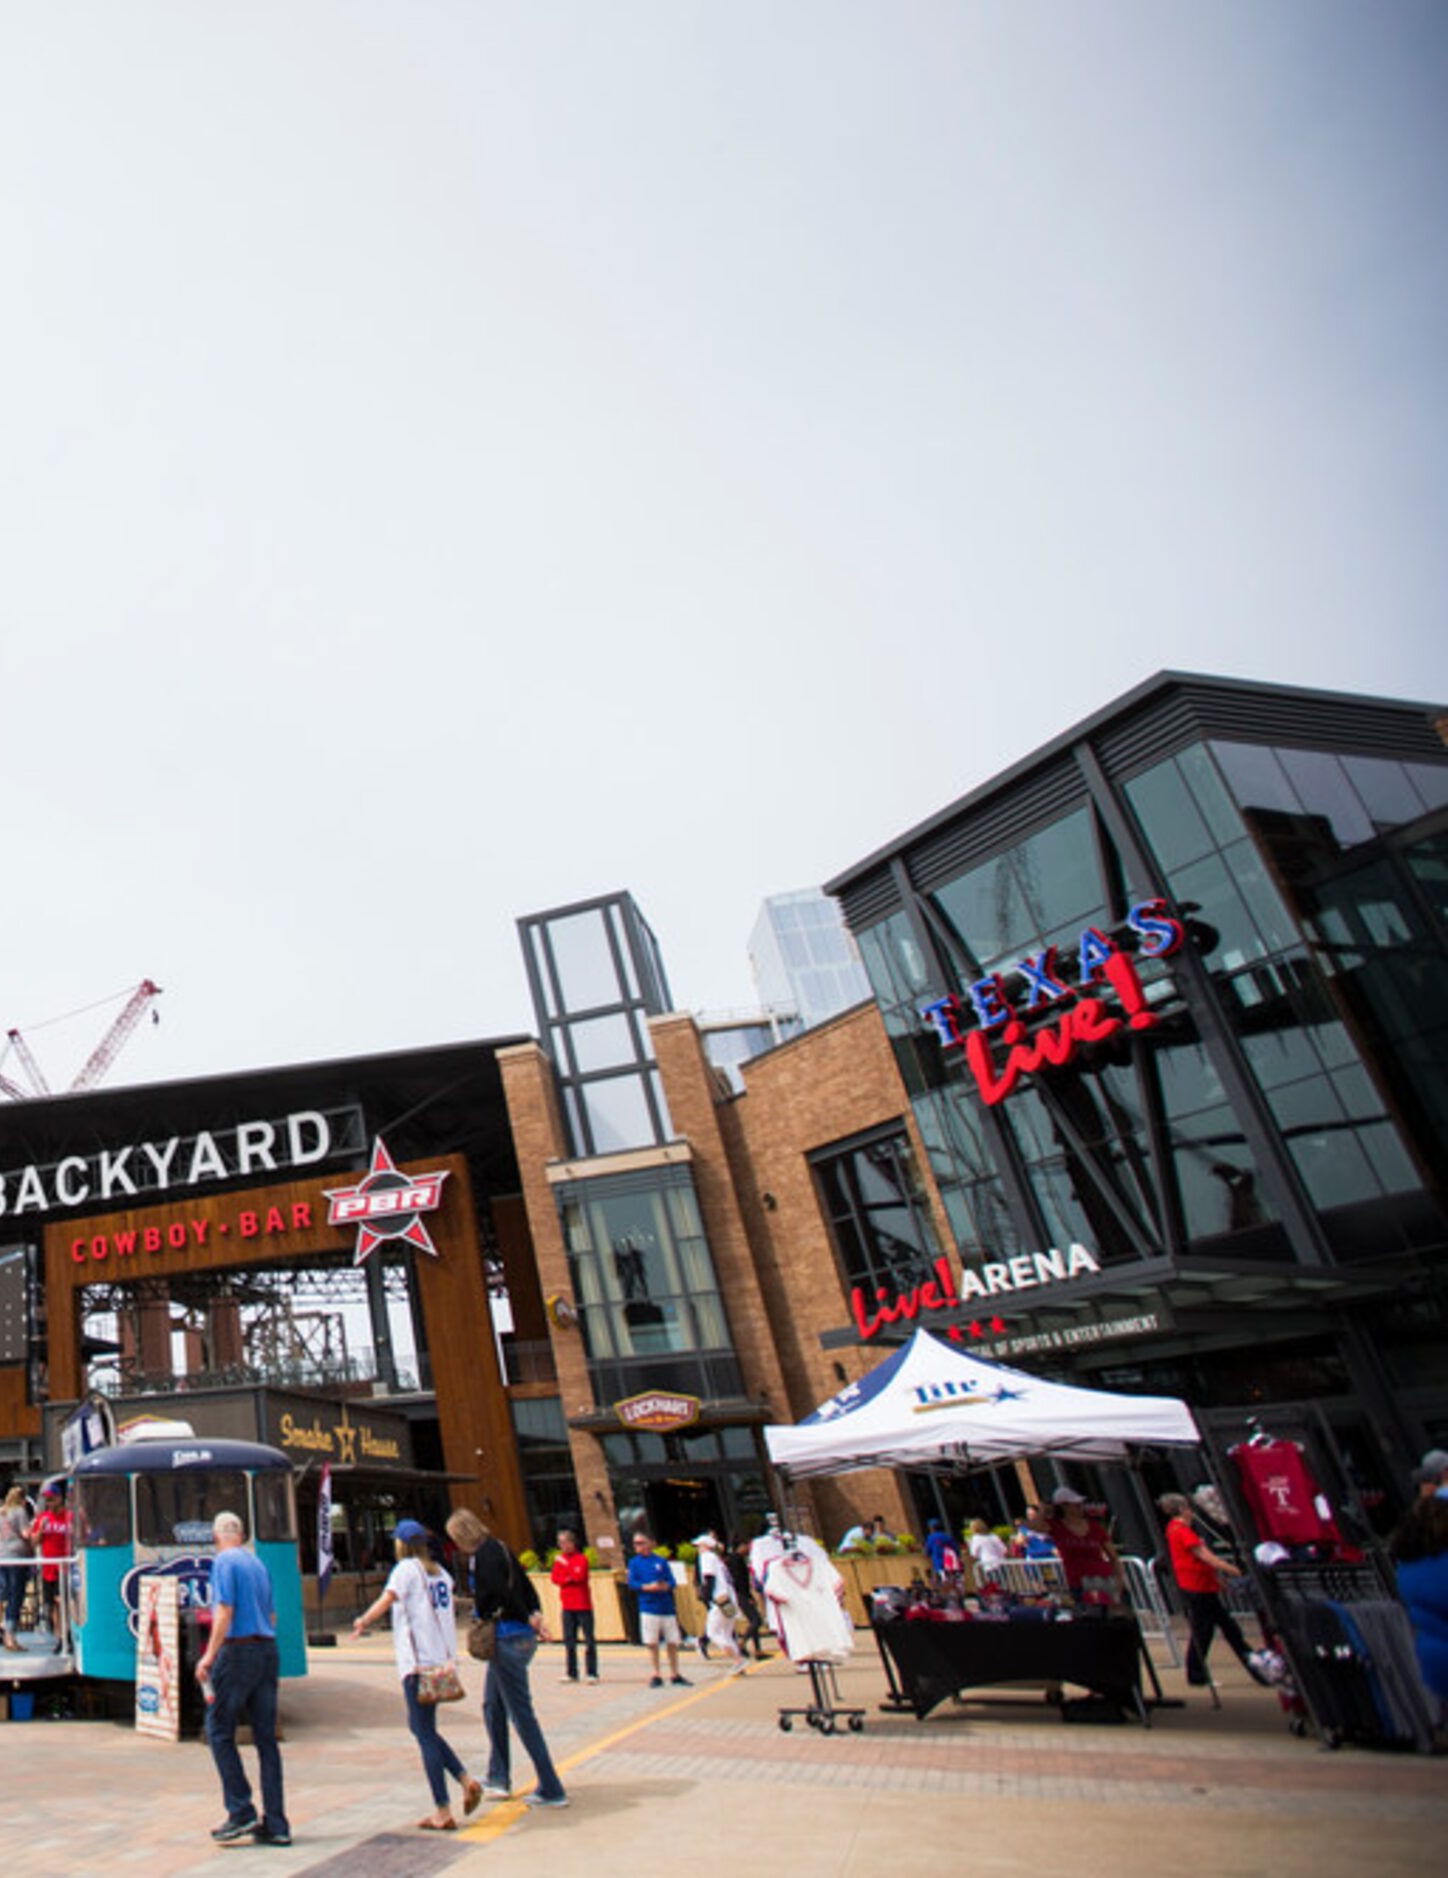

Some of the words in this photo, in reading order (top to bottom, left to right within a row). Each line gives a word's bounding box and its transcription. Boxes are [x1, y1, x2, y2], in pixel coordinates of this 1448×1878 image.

[918, 897, 1185, 1048] TEXAS
[966, 952, 1160, 1105] Live!
[336, 1185, 435, 1218] PBR
[71, 1219, 209, 1264] COWBOY
[239, 1202, 313, 1238] BAR
[851, 1256, 960, 1339] Live!
[960, 1243, 1101, 1300] ARENA
[1010, 1333, 1052, 1354] SPORTS
[1063, 1314, 1158, 1344] ENTERTAINMENT
[280, 1413, 335, 1452] Smoke
[359, 1425, 400, 1459] House
